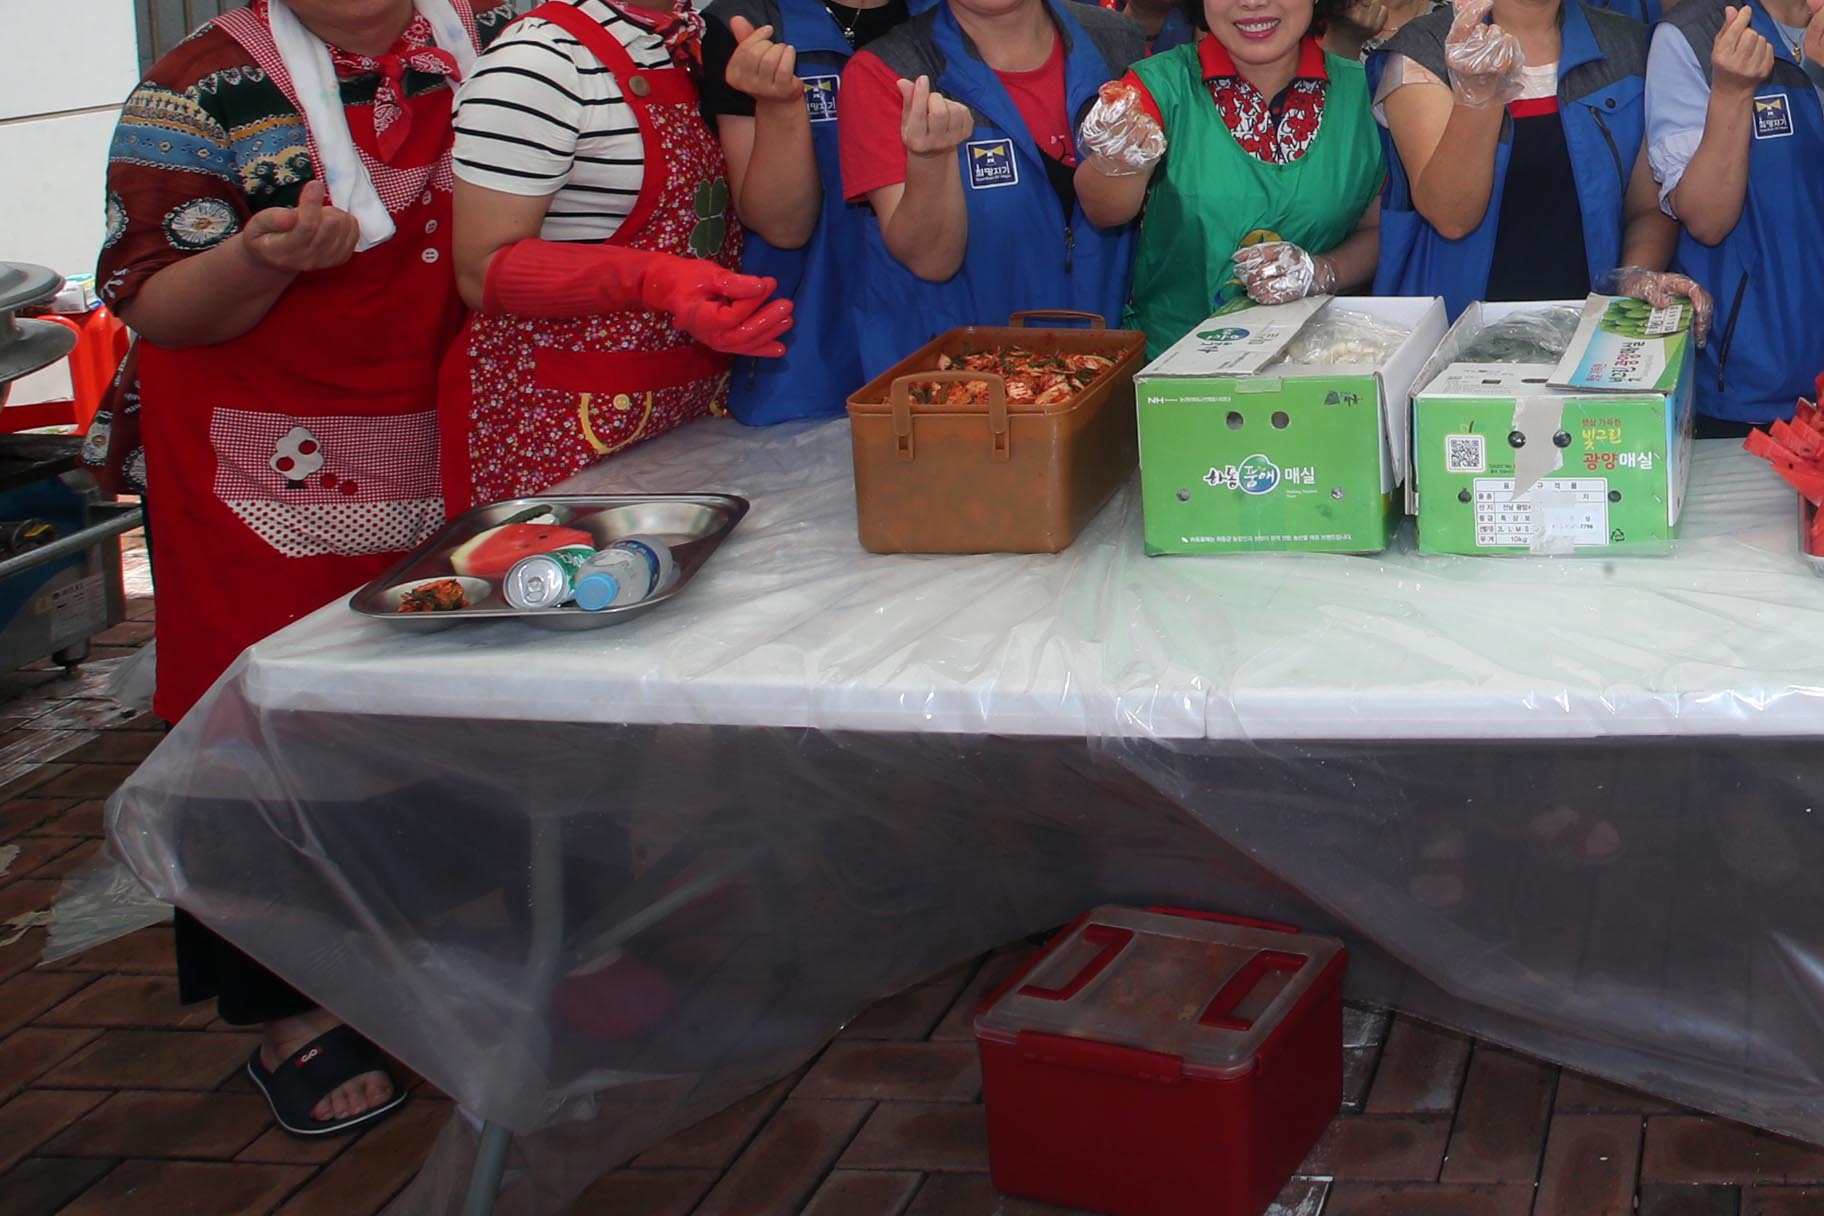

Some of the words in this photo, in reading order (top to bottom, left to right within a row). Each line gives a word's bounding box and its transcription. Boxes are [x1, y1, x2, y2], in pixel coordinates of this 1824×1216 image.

[975, 160, 1011, 177] 희망지기
[1147, 396, 1164, 404] NH
[1582, 427, 1622, 450] 빛그린
[1583, 451, 1653, 470] 광양매실
[1284, 466, 1316, 485] 매실
